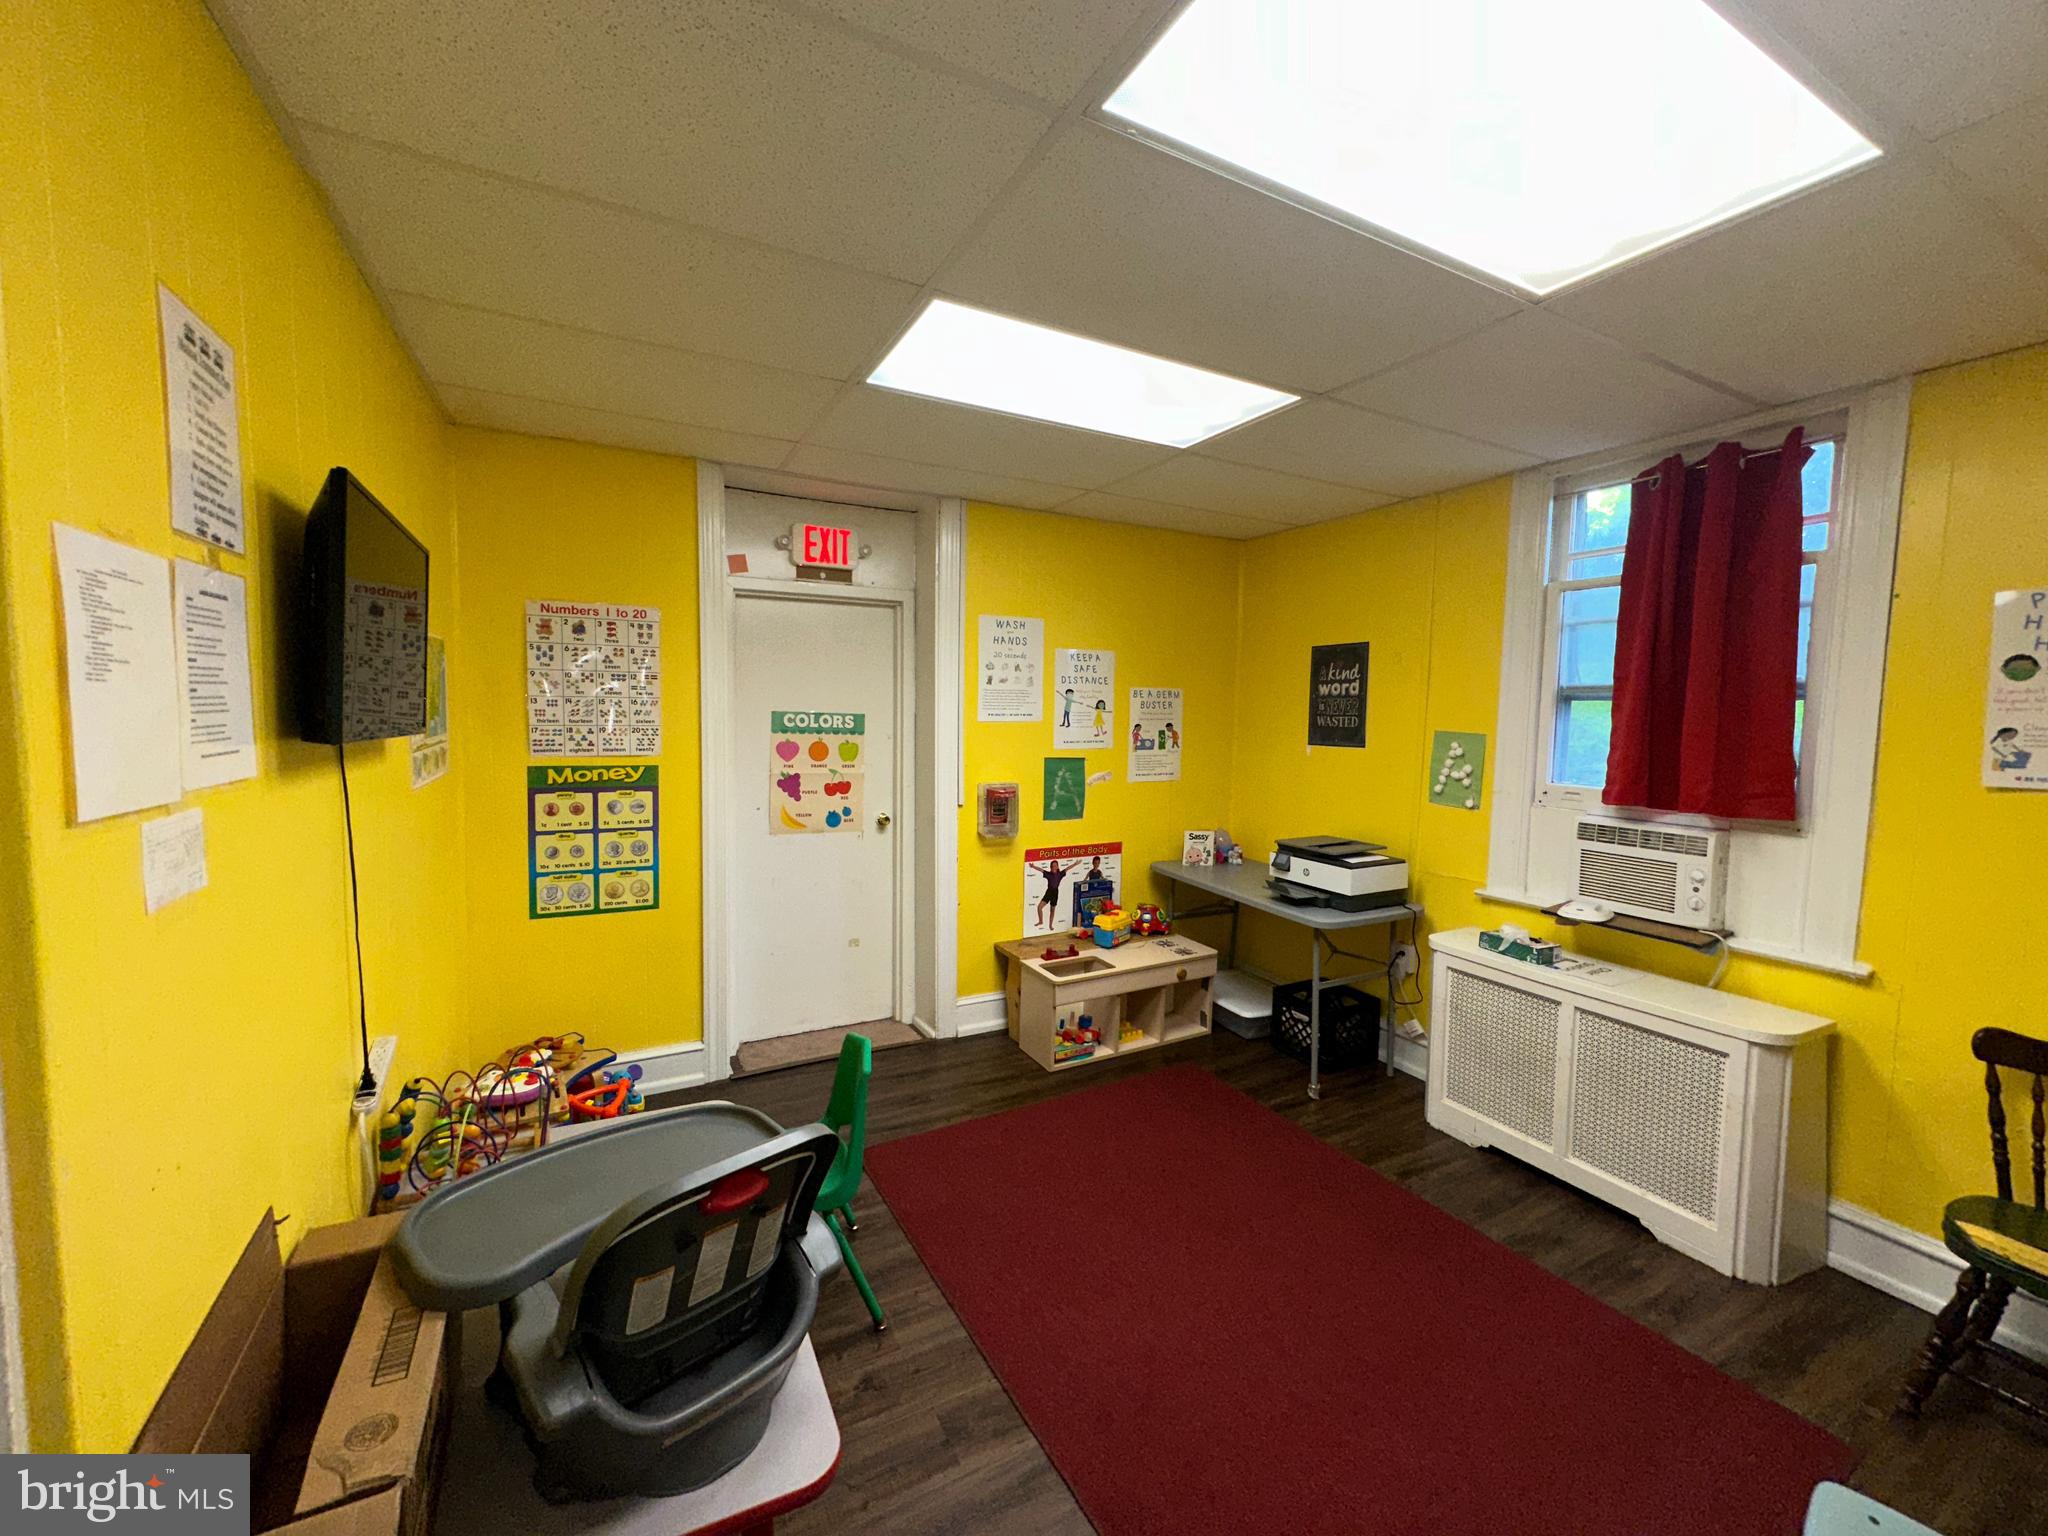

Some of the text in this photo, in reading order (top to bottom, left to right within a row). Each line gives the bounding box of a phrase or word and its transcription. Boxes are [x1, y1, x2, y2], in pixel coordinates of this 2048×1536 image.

[804, 525, 851, 565] EXIT
[540, 603, 600, 616] Numbers
[616, 607, 628, 618] to
[632, 609, 647, 619] 20
[564, 618, 569, 626] 2
[597, 620, 602, 628] 3
[996, 619, 1026, 630] WASH
[993, 636, 1028, 646] HANDS
[1004, 652, 1028, 660] seconds
[1070, 653, 1101, 662] KEEP A
[1074, 664, 1098, 674] SAFE
[1328, 662, 1361, 680] kind
[1061, 676, 1109, 686] DISTANCE
[1318, 680, 1360, 696] word
[1133, 690, 1180, 699] BE A GERM
[630, 698, 638, 706] 16
[1140, 700, 1173, 710] BUSTER
[784, 713, 855, 728] COLORS
[1316, 715, 1360, 728] WASTED
[547, 766, 646, 785] Money
[1188, 832, 1210, 841] Sassy
[1040, 850, 1060, 858] Parts
[1062, 848, 1070, 856] of
[1088, 846, 1108, 854] Body
